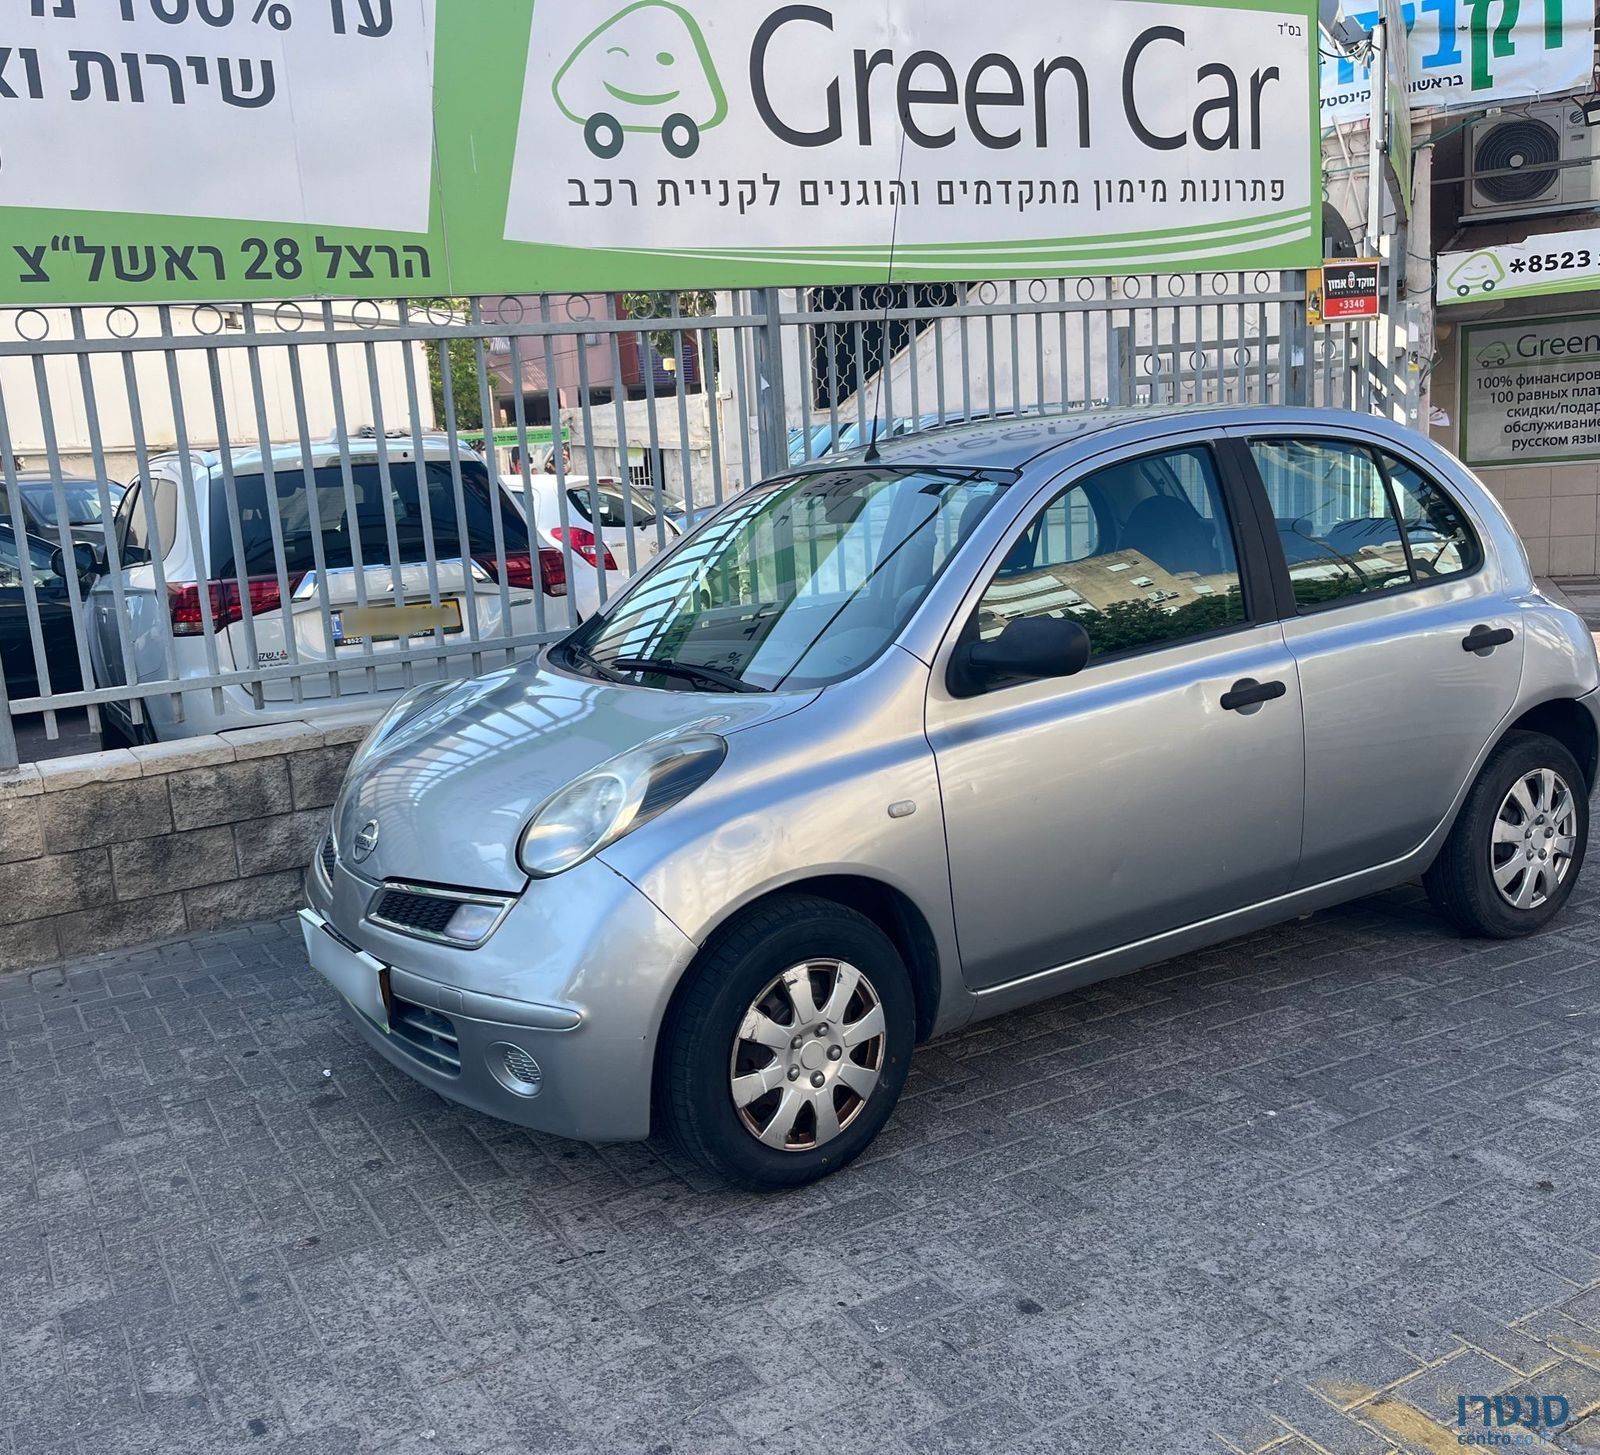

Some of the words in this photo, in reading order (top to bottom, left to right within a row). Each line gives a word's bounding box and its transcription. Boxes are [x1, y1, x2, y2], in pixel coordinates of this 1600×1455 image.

[68, 49, 276, 108] שירות
[749, 4, 1091, 150] Green
[1121, 25, 1281, 151] Car
[568, 178, 638, 207] רכב
[657, 172, 781, 215] לקניית
[800, 179, 920, 206] והוגנים
[937, 180, 1079, 212] מתקדמים
[1093, 179, 1167, 211] מימון
[1180, 179, 1285, 202] פתרונות
[240, 238, 303, 281] 28
[315, 235, 431, 279] הרצל
[1328, 279, 1347, 292] אמון
[1356, 277, 1375, 290] מוקד
[1516, 334, 1600, 358] Green
[1477, 376, 1513, 390] 100%
[1491, 390, 1514, 404] 100
[1517, 387, 1568, 404] равных
[1512, 436, 1568, 451] русском
[1571, 433, 1600, 444] язы
